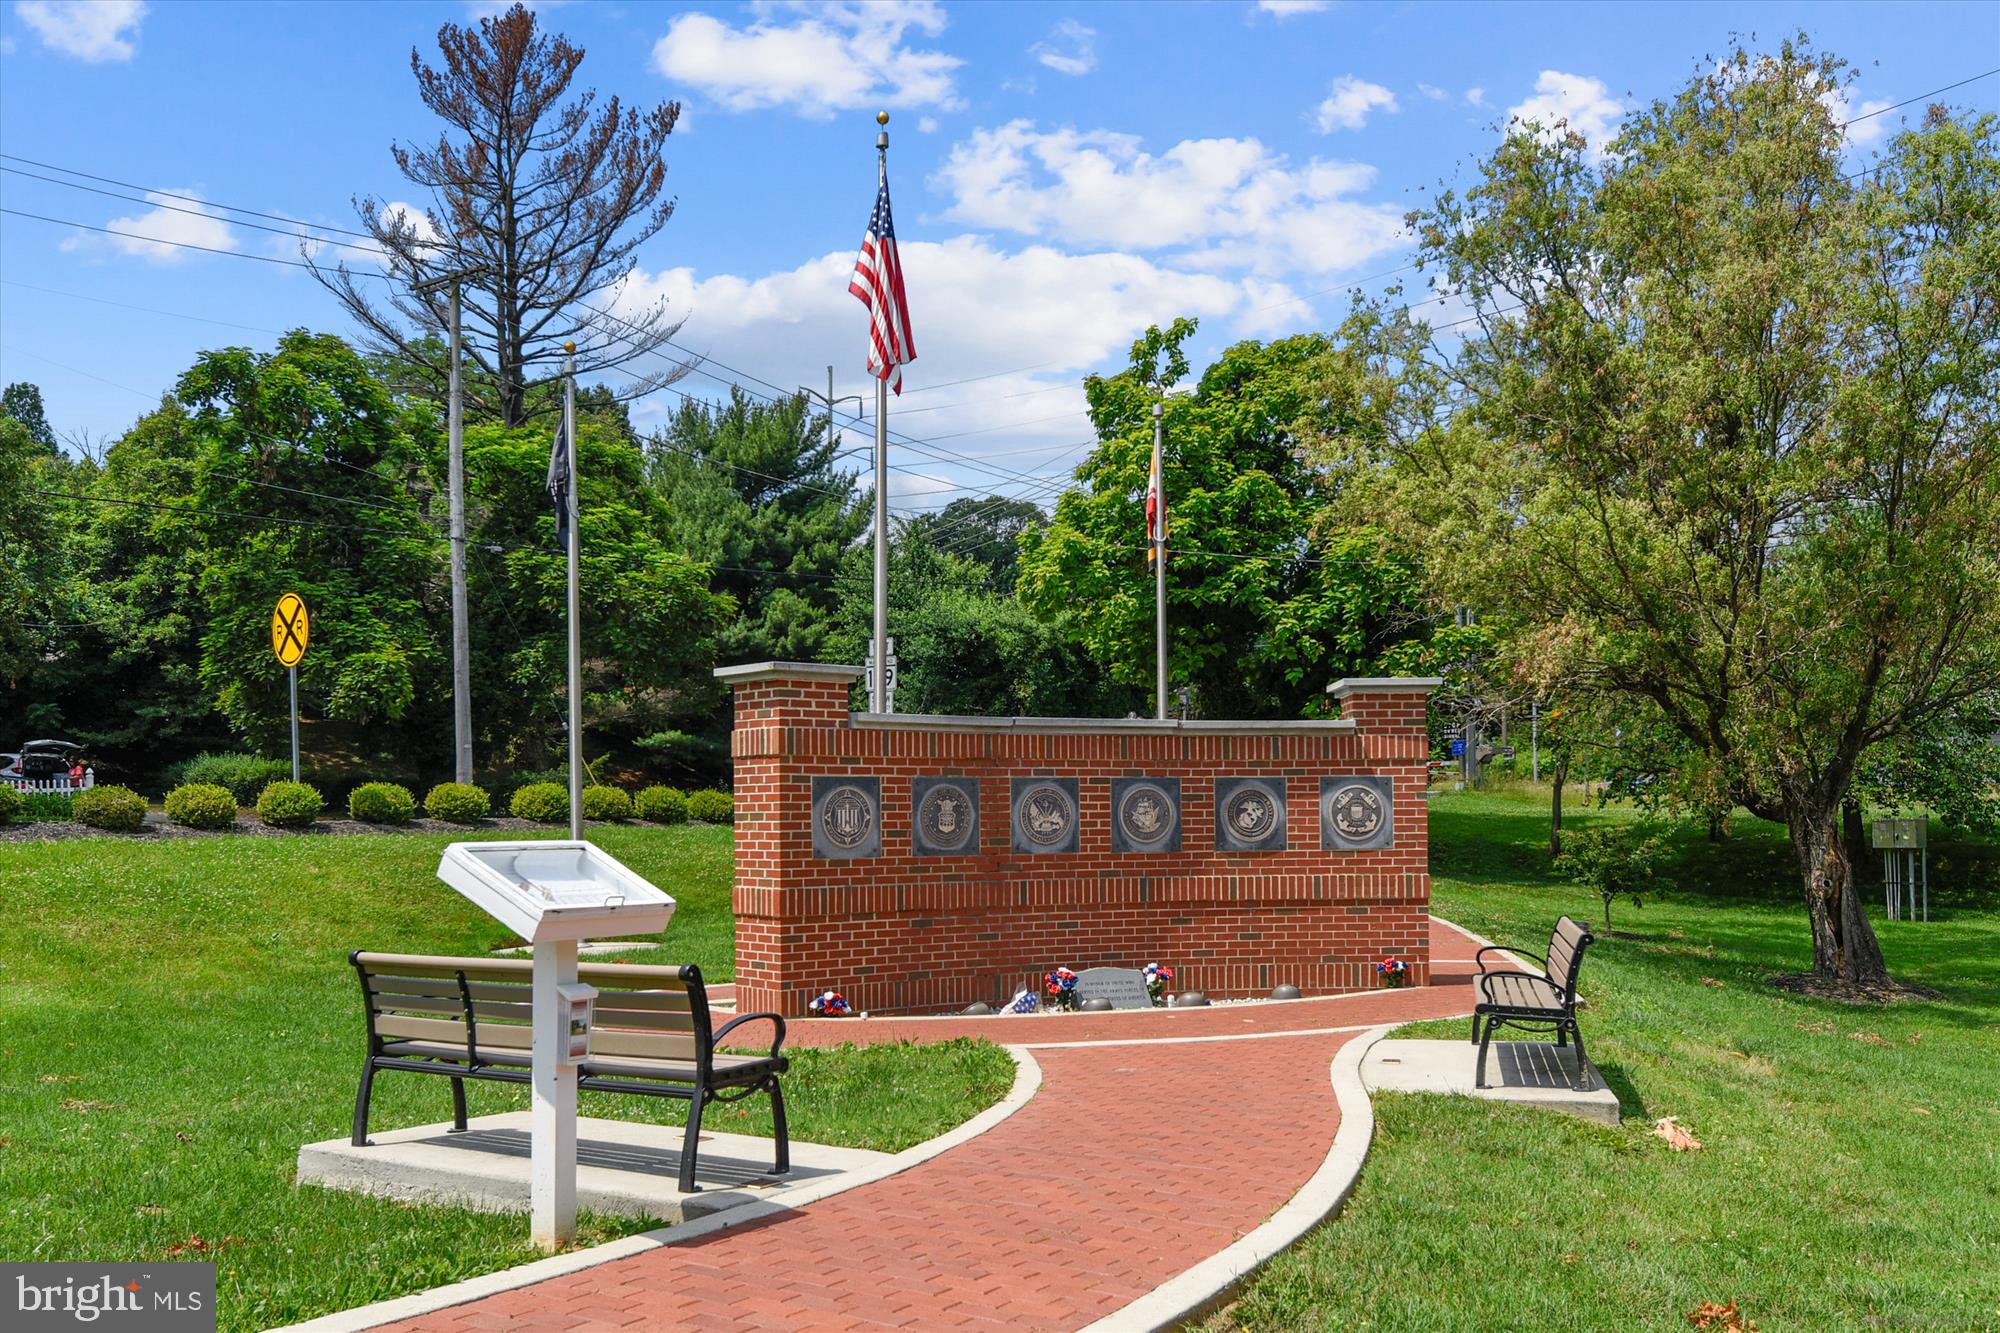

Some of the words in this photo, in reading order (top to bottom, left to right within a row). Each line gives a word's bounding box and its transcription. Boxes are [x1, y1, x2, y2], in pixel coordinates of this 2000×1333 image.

[277, 624, 282, 640] R
[297, 619, 303, 636] R
[868, 669, 893, 688] 19
